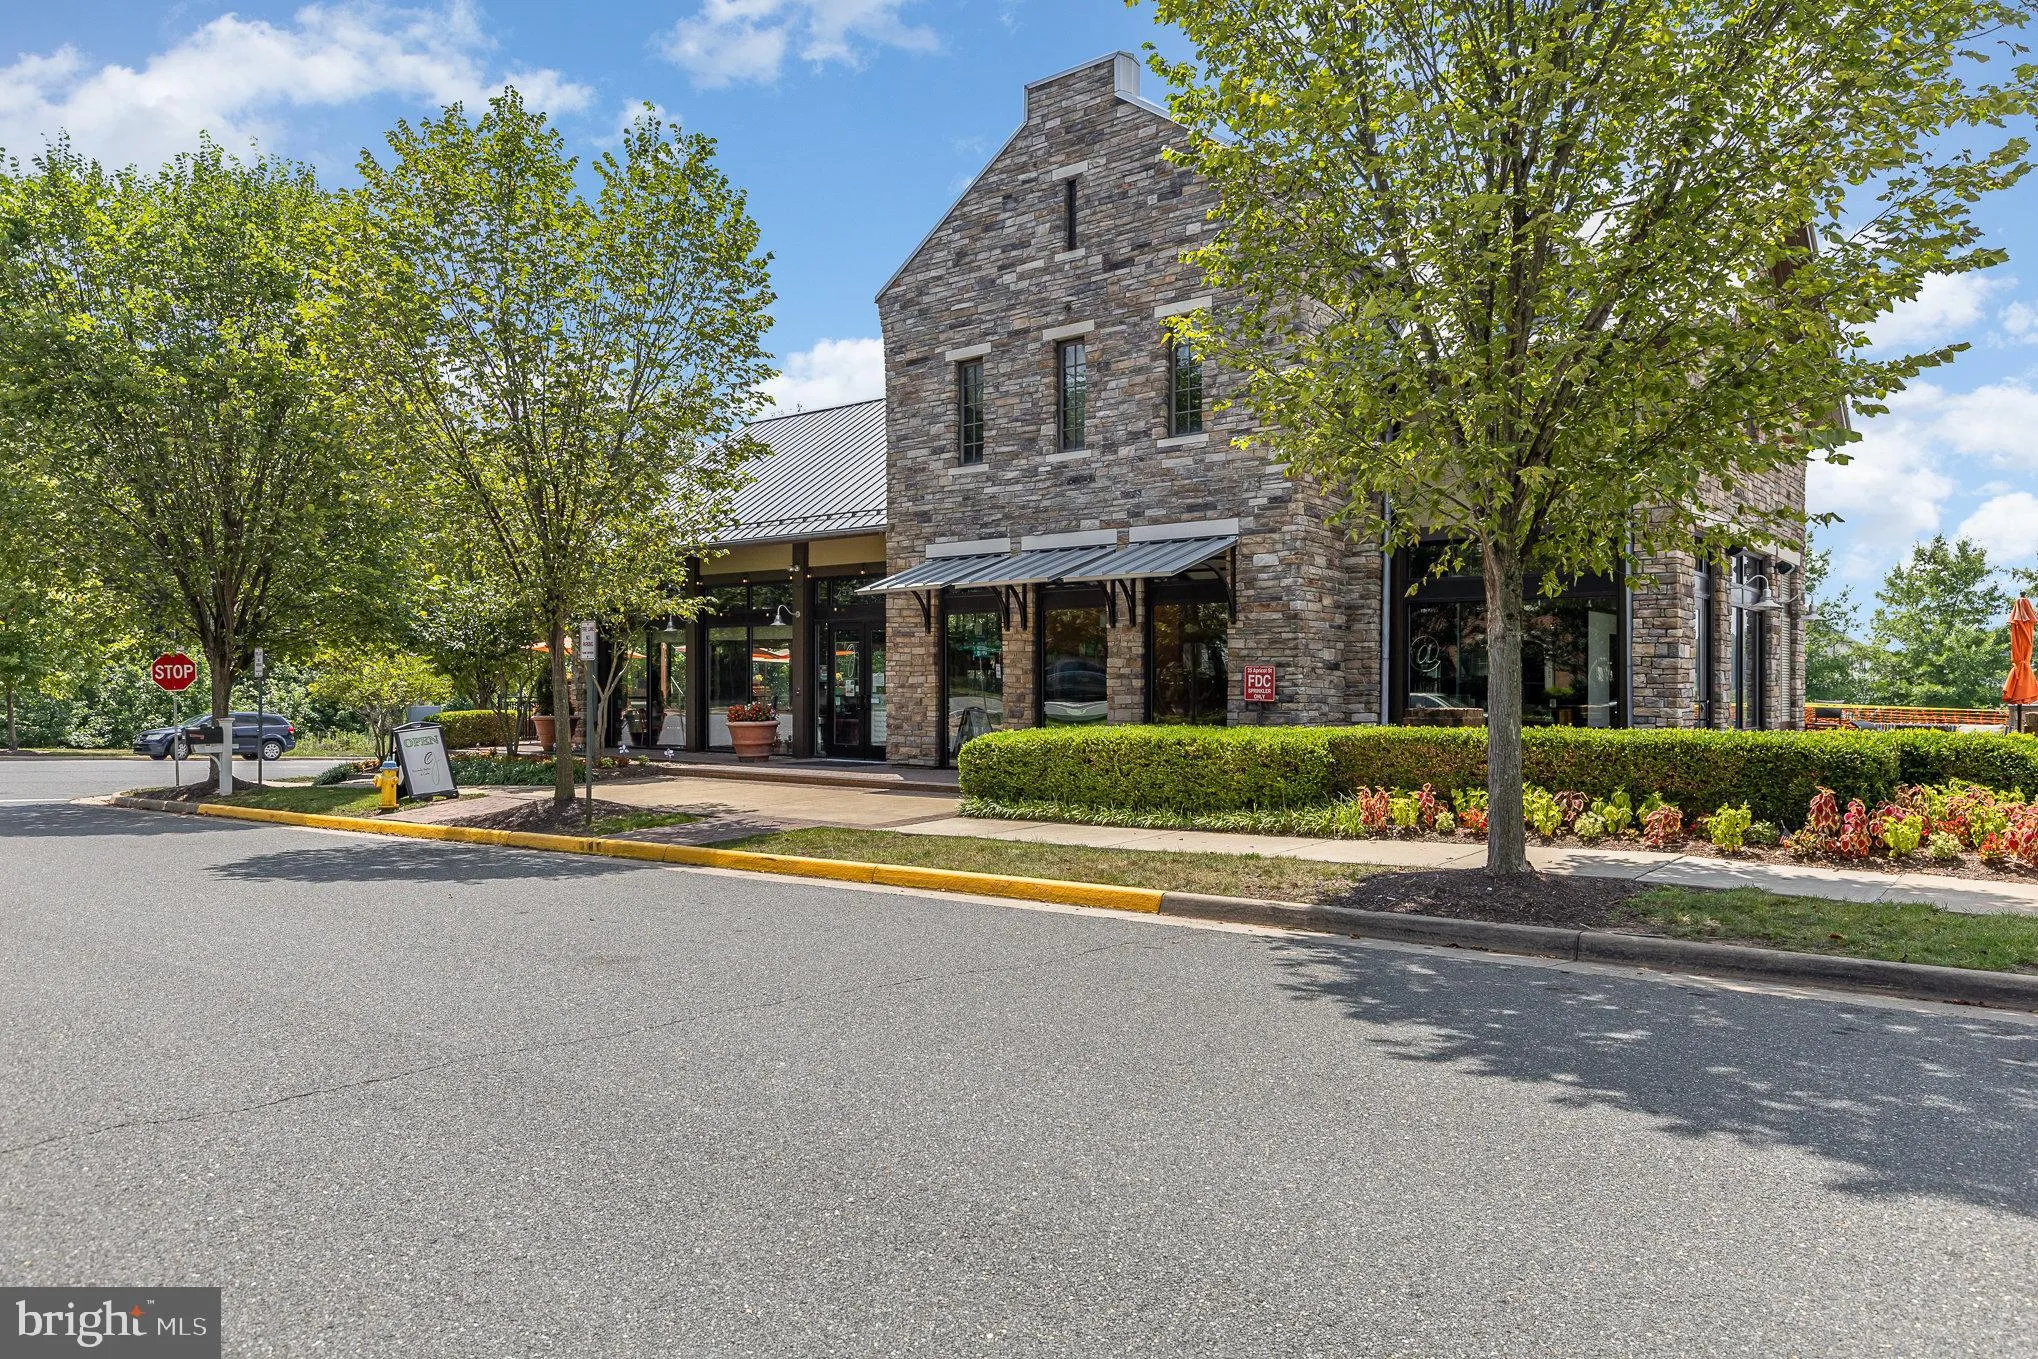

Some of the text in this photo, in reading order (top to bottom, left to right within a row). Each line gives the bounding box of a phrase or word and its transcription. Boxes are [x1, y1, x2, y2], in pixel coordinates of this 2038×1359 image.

[154, 664, 193, 680] STOP
[1248, 674, 1272, 688] FDC
[404, 735, 440, 748] OPEN
